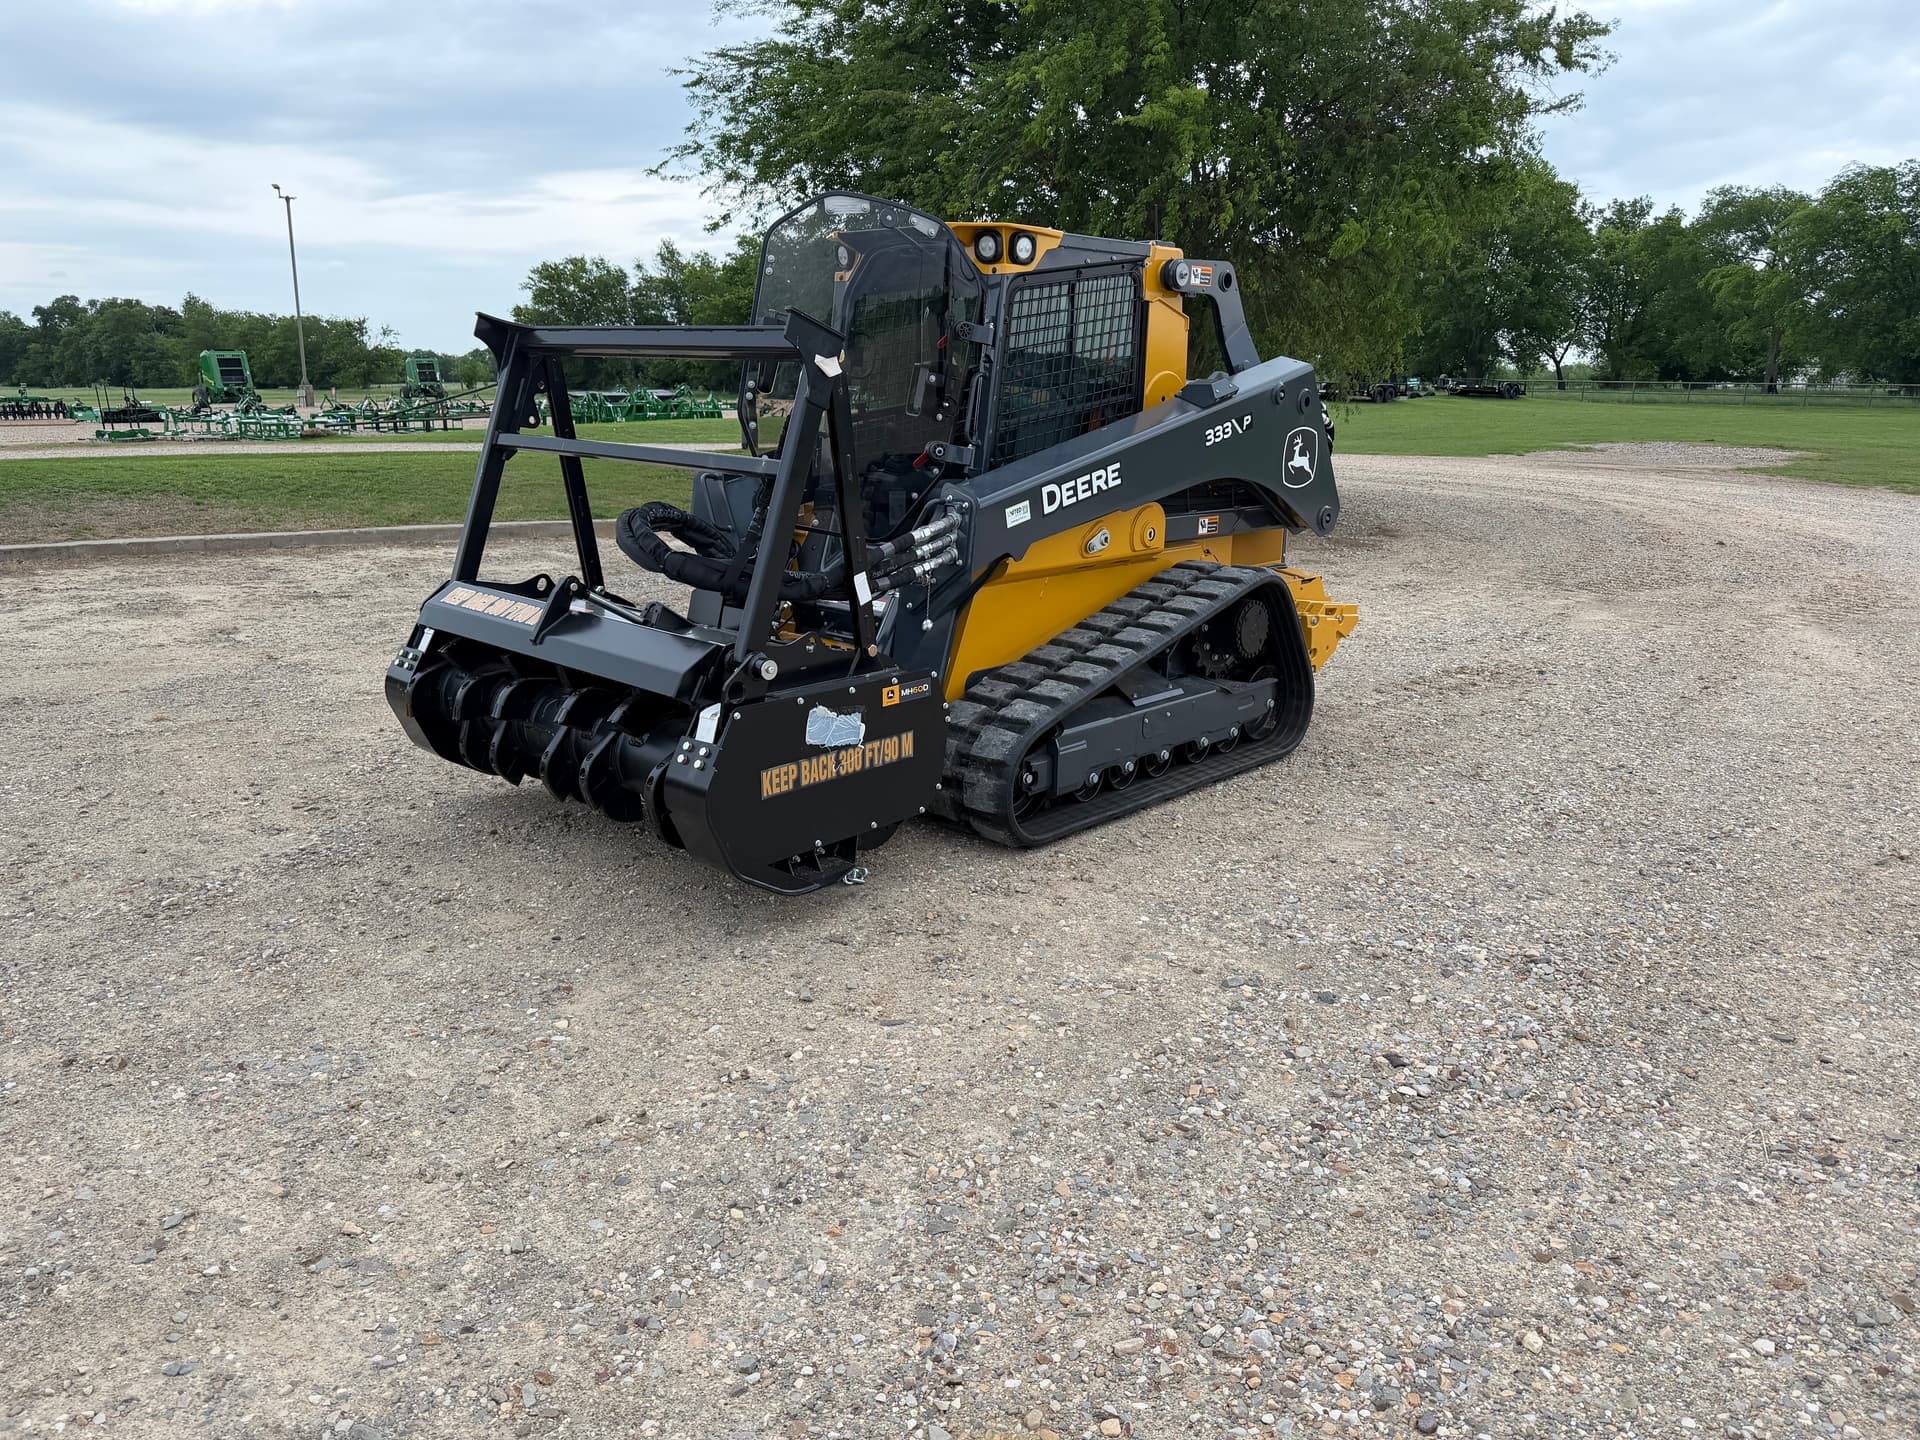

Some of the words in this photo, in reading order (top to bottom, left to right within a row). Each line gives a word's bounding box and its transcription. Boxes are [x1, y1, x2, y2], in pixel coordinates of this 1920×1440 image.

[1041, 462, 1122, 515] DEERE
[901, 683, 929, 697] MH60D
[762, 765, 798, 798] KEEP
[801, 754, 837, 786] BACK
[839, 749, 863, 775] 300
[865, 737, 899, 768] FT/90
[902, 731, 914, 758] M
